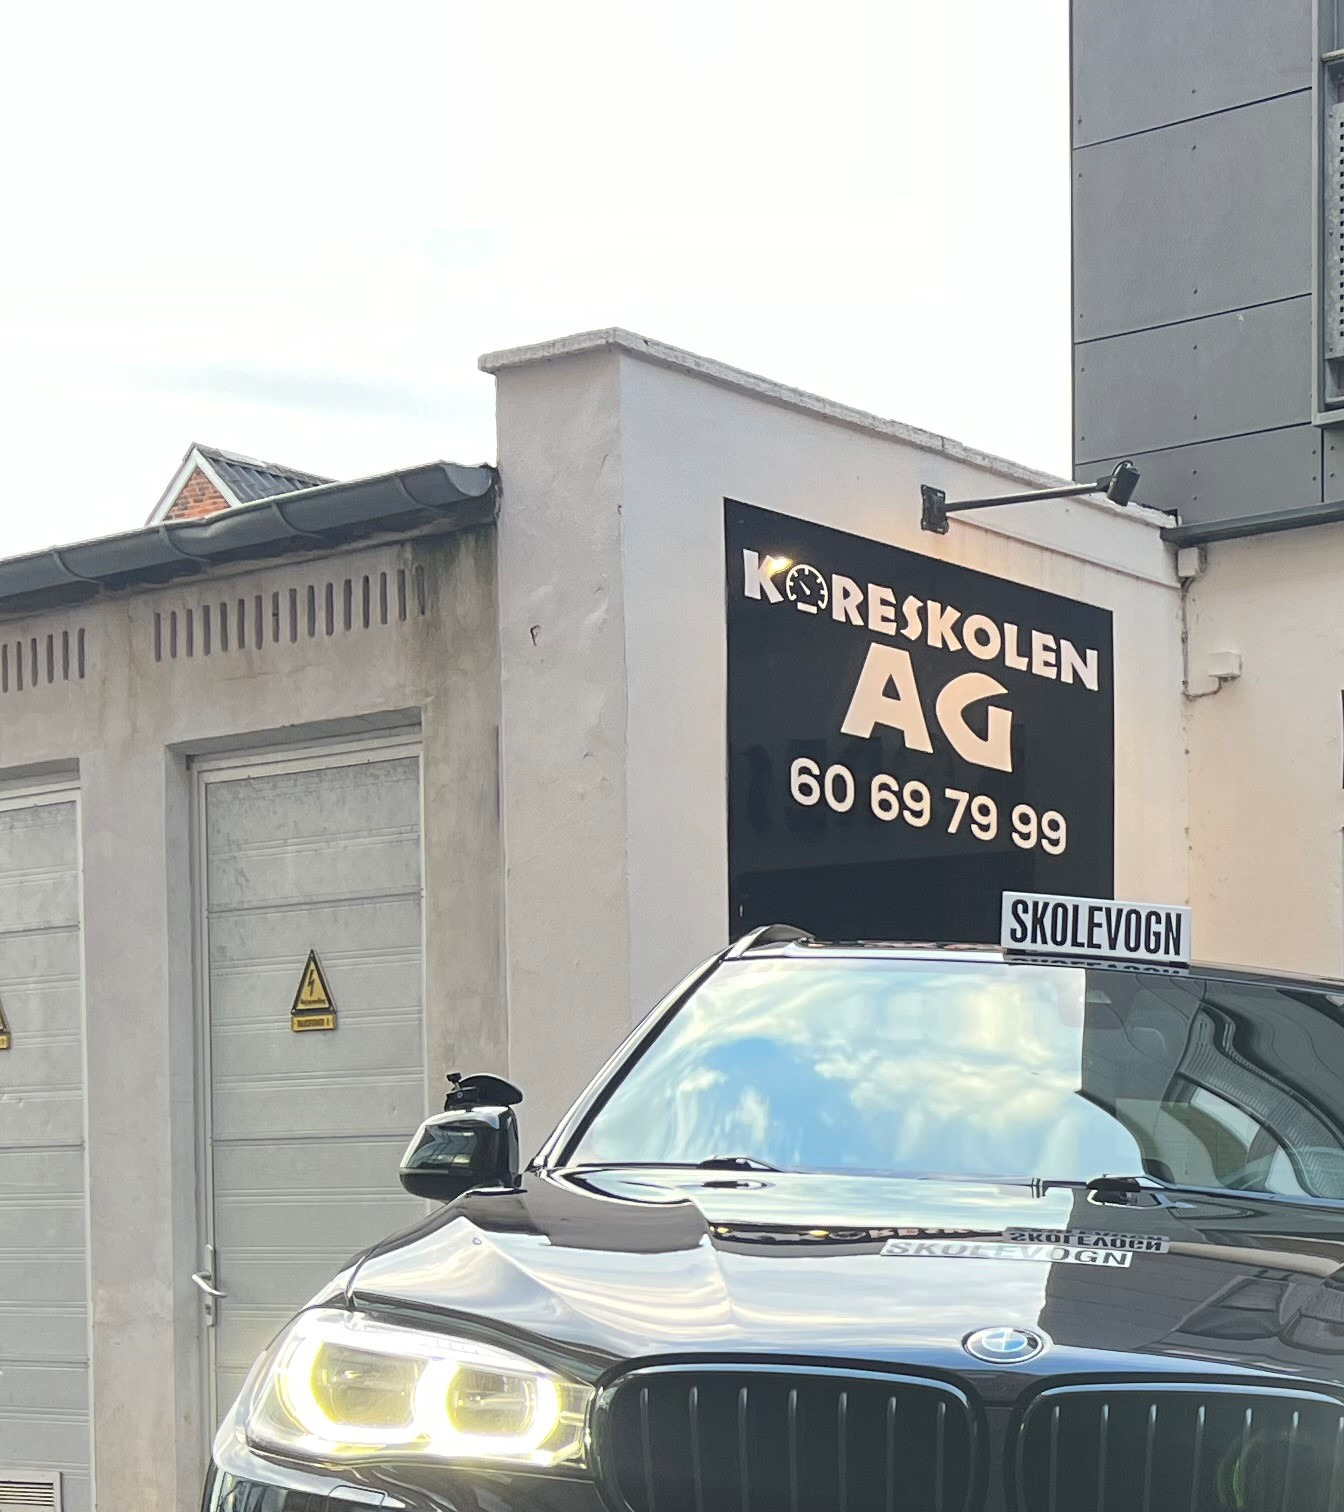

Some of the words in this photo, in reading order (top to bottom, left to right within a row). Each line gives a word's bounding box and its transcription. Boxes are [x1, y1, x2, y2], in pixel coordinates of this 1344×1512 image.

[841, 642, 1012, 772] AG
[790, 757, 855, 813] 60
[871, 774, 931, 828] 69
[945, 788, 998, 841] 79
[1011, 804, 1067, 855] 99
[1010, 899, 1182, 956] SKOLEVOGN
